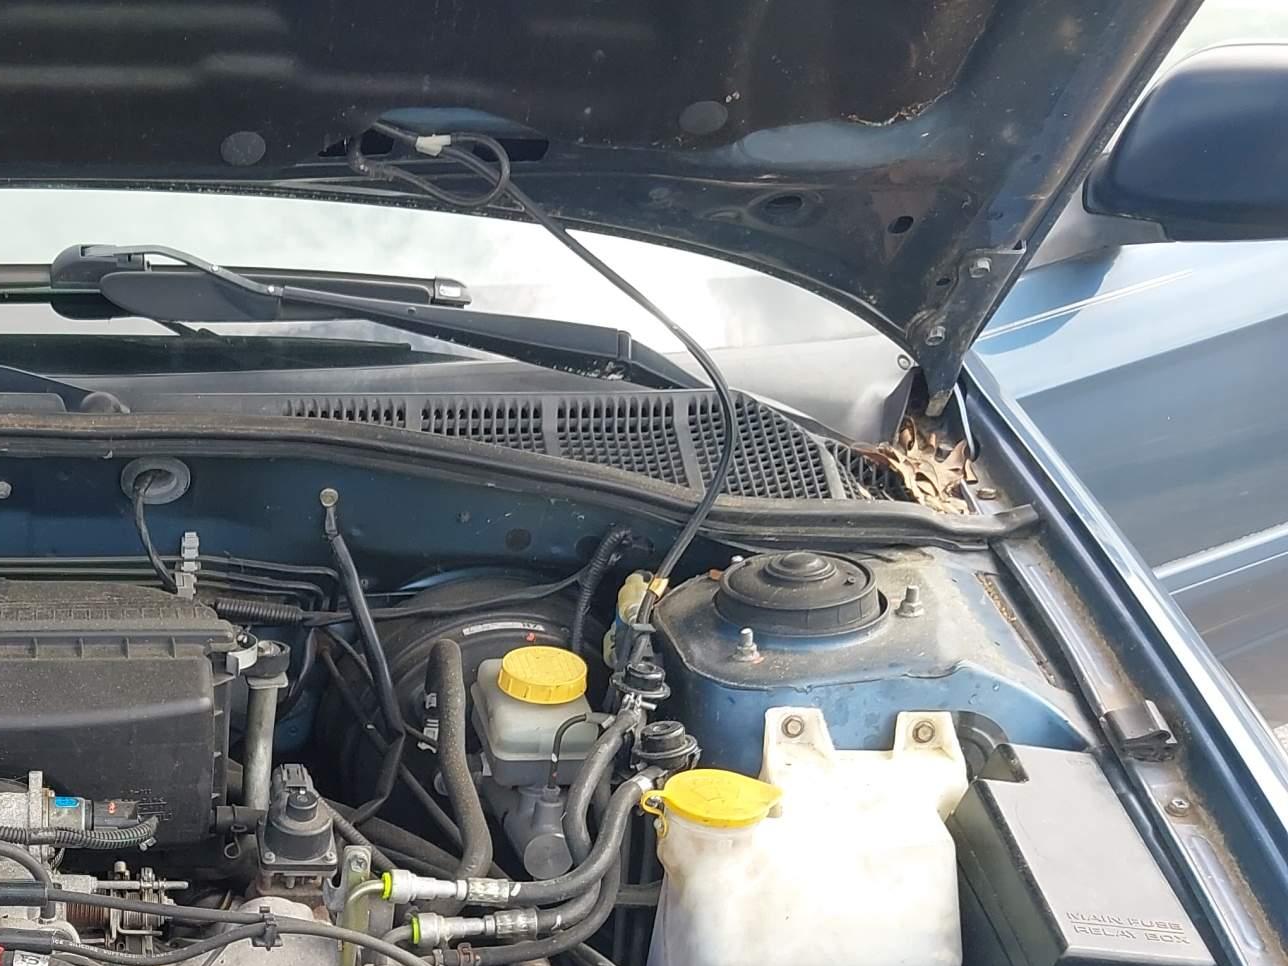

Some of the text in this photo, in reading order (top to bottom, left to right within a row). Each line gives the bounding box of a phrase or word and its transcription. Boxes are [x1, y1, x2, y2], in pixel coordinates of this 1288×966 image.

[1066, 912, 1183, 931] MAIN FUSE
[1074, 925, 1190, 944] RELAY BOX
